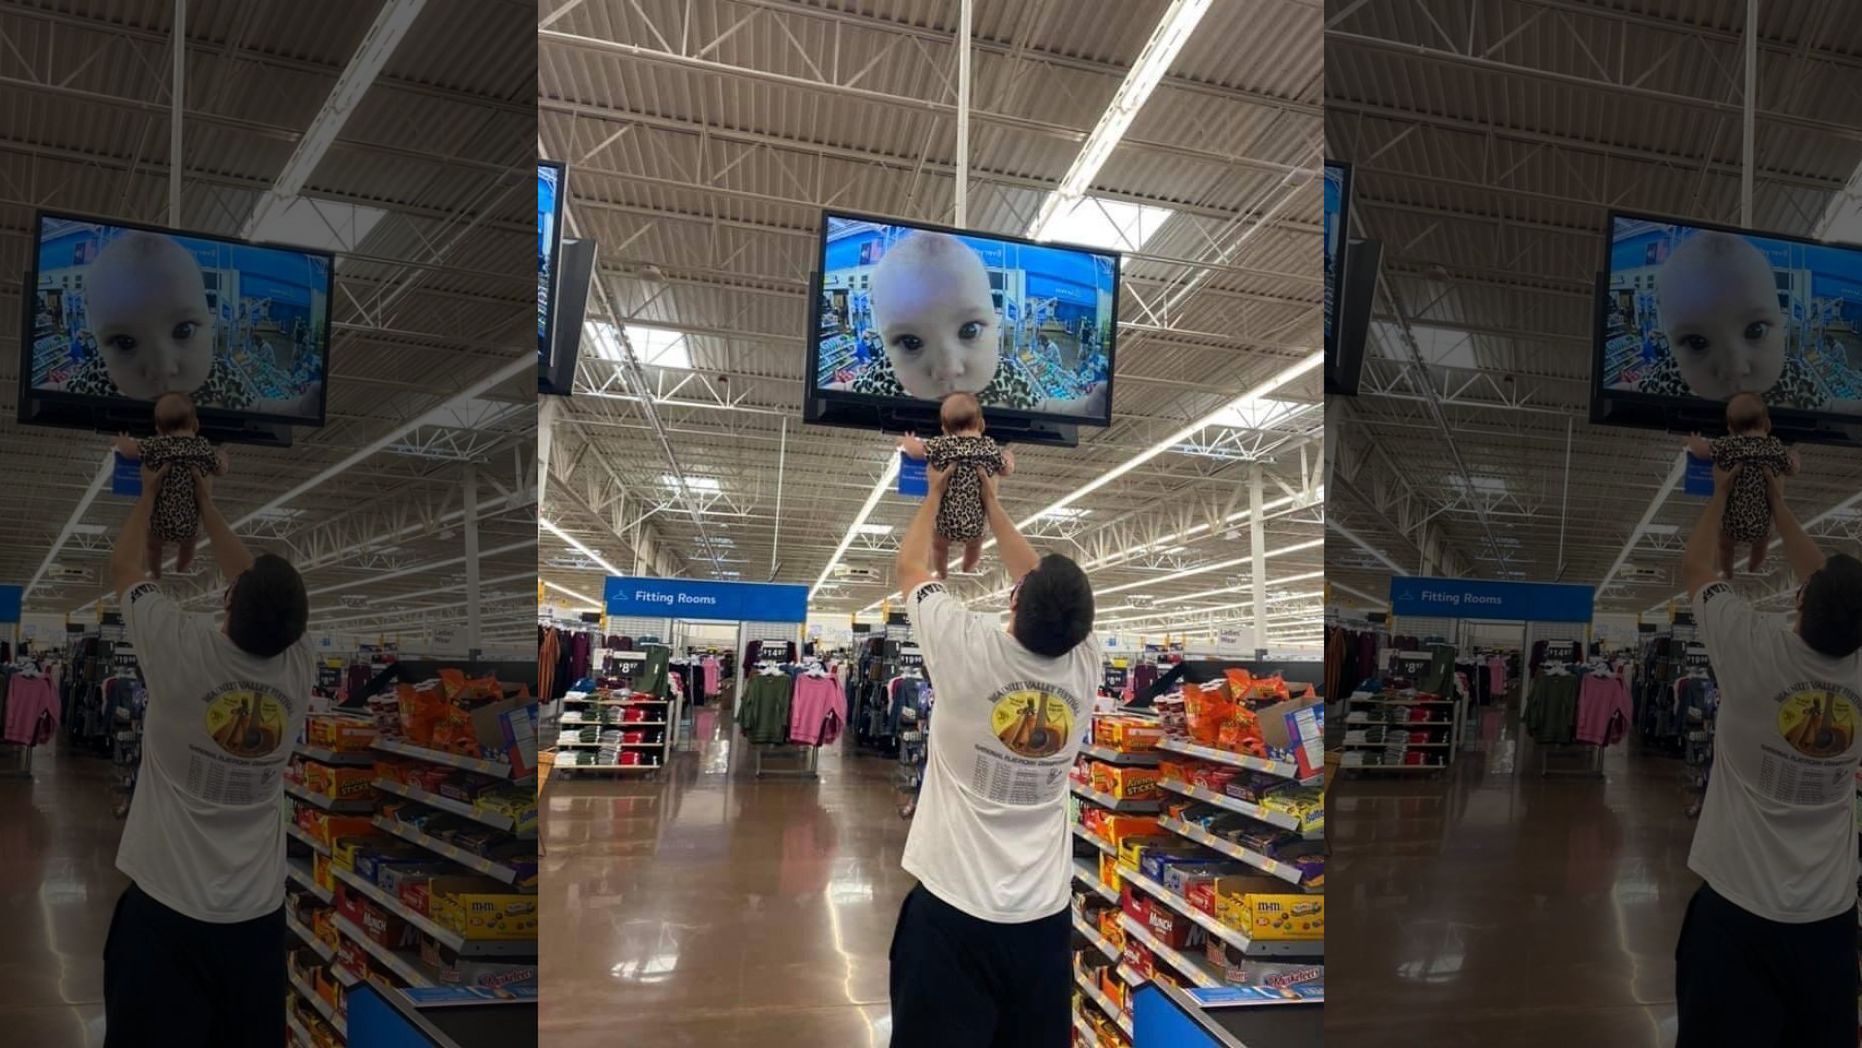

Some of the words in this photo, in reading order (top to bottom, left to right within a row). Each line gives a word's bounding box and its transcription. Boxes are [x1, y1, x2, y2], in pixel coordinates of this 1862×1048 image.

[635, 590, 674, 606] Fitting
[678, 592, 716, 606] Rooms
[1421, 590, 1460, 606] Fitting
[1464, 592, 1502, 606] Rooms
[1148, 912, 1173, 931] MUNCH
